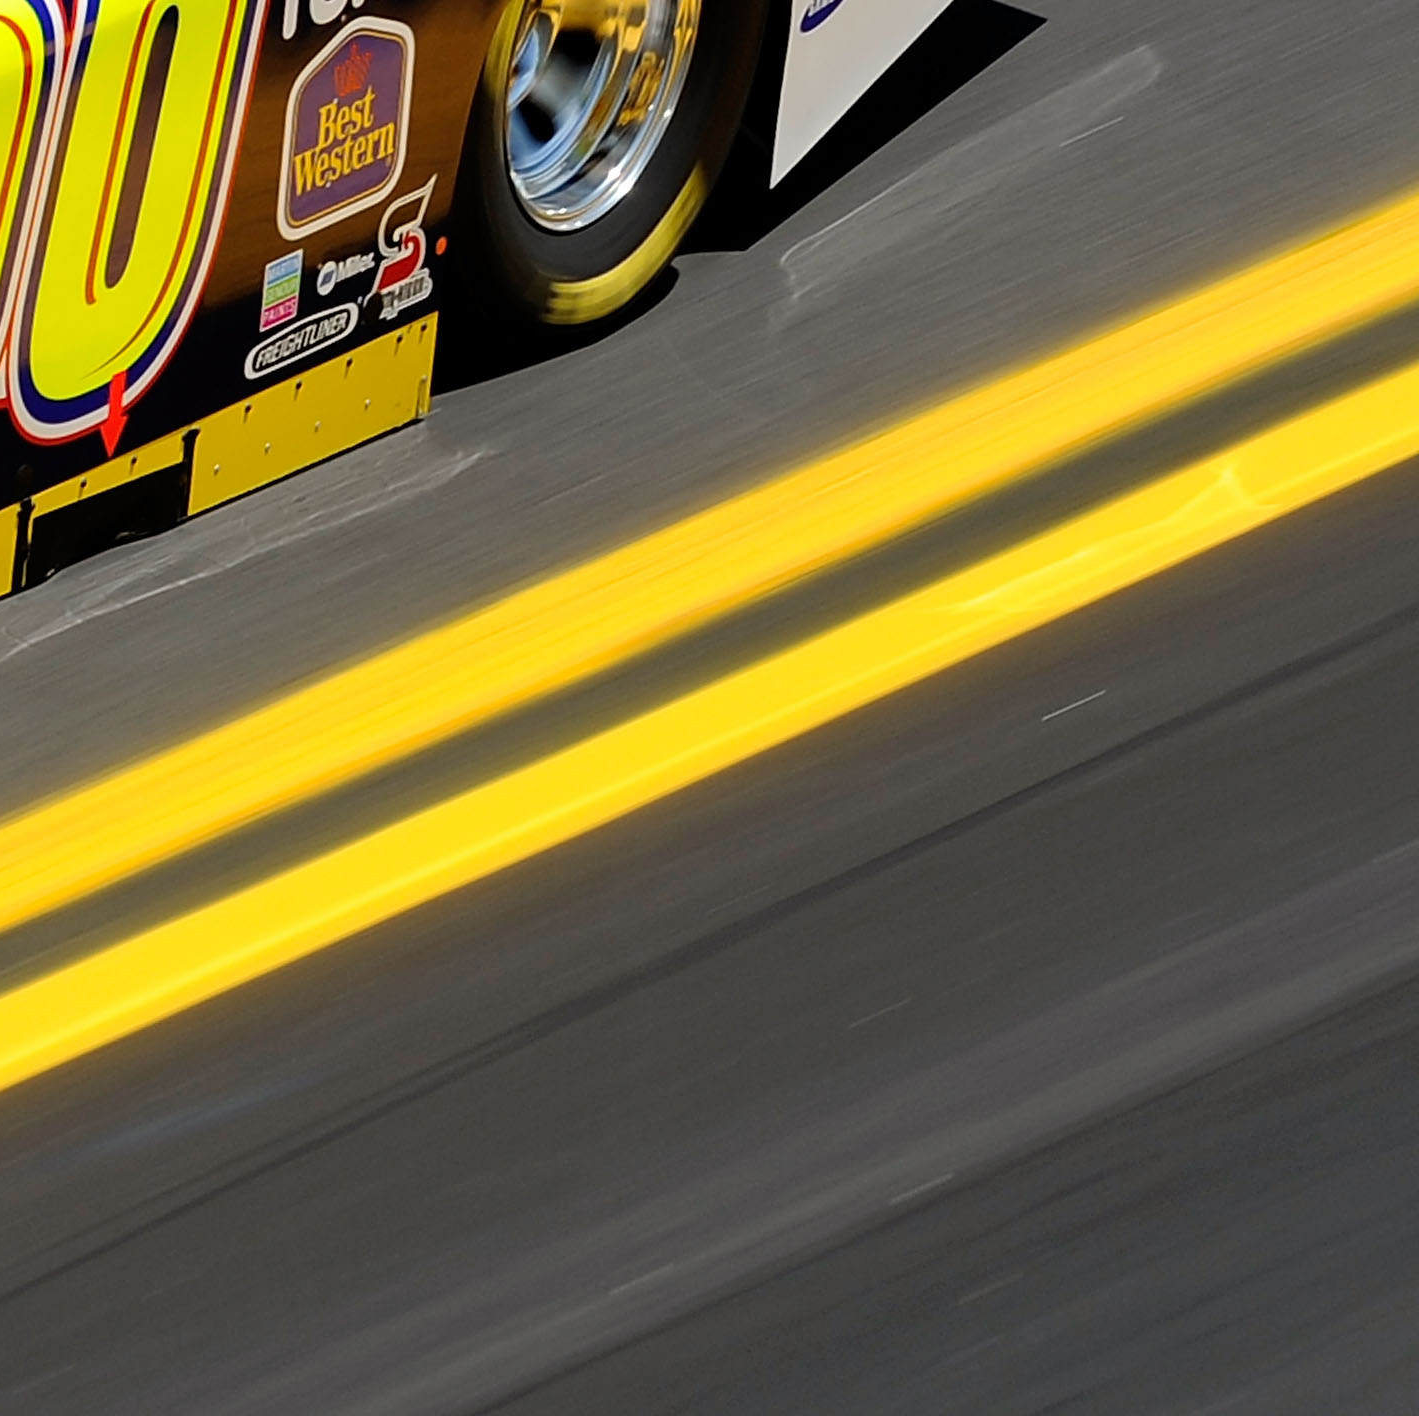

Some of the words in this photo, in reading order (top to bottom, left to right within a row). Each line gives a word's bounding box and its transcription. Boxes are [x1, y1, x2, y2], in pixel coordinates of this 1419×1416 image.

[318, 87, 376, 148] Best
[293, 122, 395, 197] Western
[256, 312, 348, 369] FREIGHTLINER
